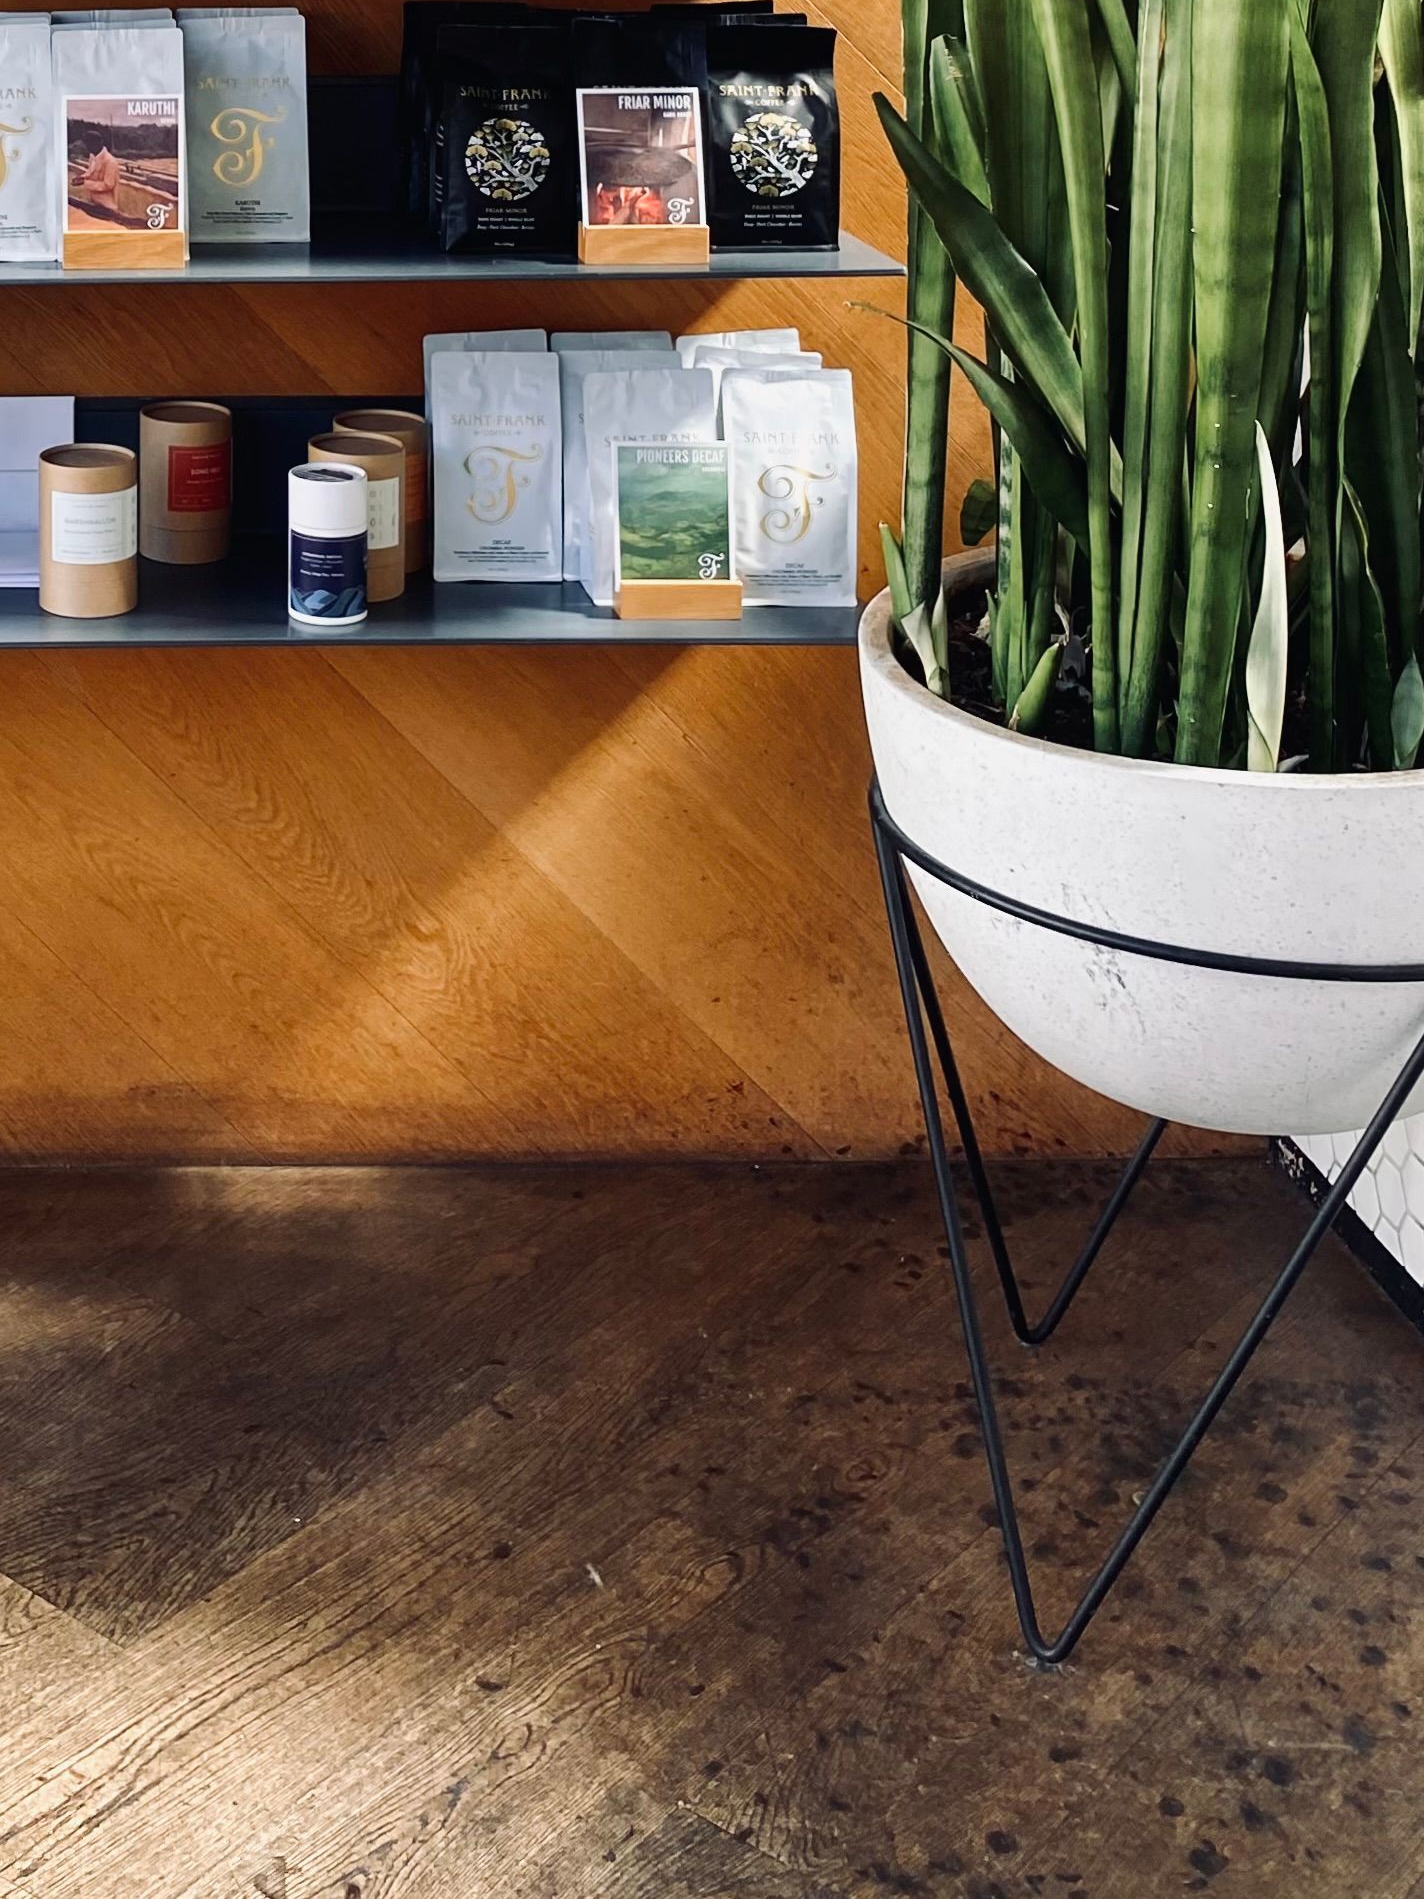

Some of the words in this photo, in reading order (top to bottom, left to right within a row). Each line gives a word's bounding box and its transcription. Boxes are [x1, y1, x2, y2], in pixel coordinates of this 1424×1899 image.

[719, 85, 763, 97] SAINT
[127, 100, 176, 115] KARUTHI
[618, 95, 650, 109] FRIAR
[653, 95, 691, 109] MINOR
[451, 414, 492, 426] SAINT
[496, 414, 545, 427] FRANK
[743, 431, 785, 445] SAINT
[636, 449, 689, 463] PIONEERS
[691, 449, 725, 463] DECAF
